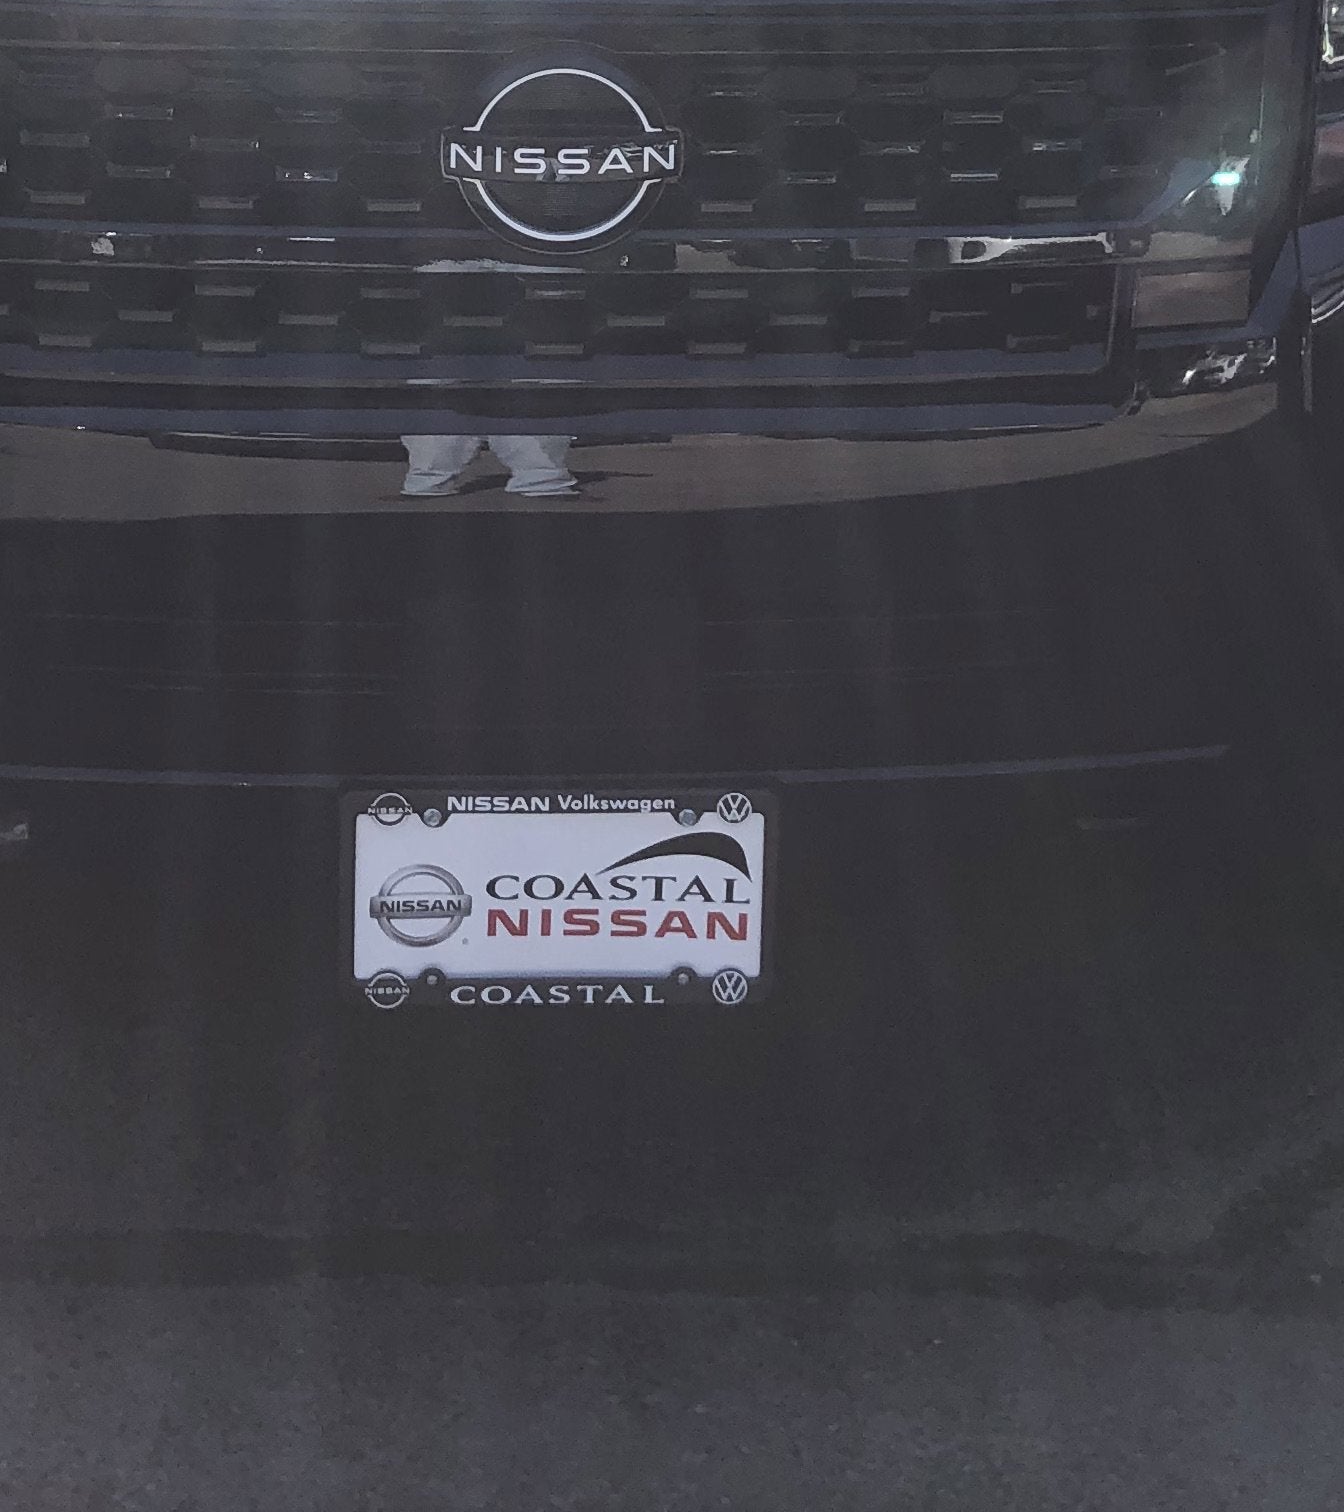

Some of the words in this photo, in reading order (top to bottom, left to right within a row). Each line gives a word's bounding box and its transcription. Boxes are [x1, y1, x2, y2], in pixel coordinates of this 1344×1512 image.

[449, 141, 677, 175] NISSAN
[447, 795, 550, 812] NISSAN
[558, 794, 676, 812] Volkswagen
[486, 872, 752, 905] COASTAL
[380, 899, 462, 914] NISSAN
[487, 908, 748, 941] NISSAN
[450, 984, 665, 1005] COASTAL
